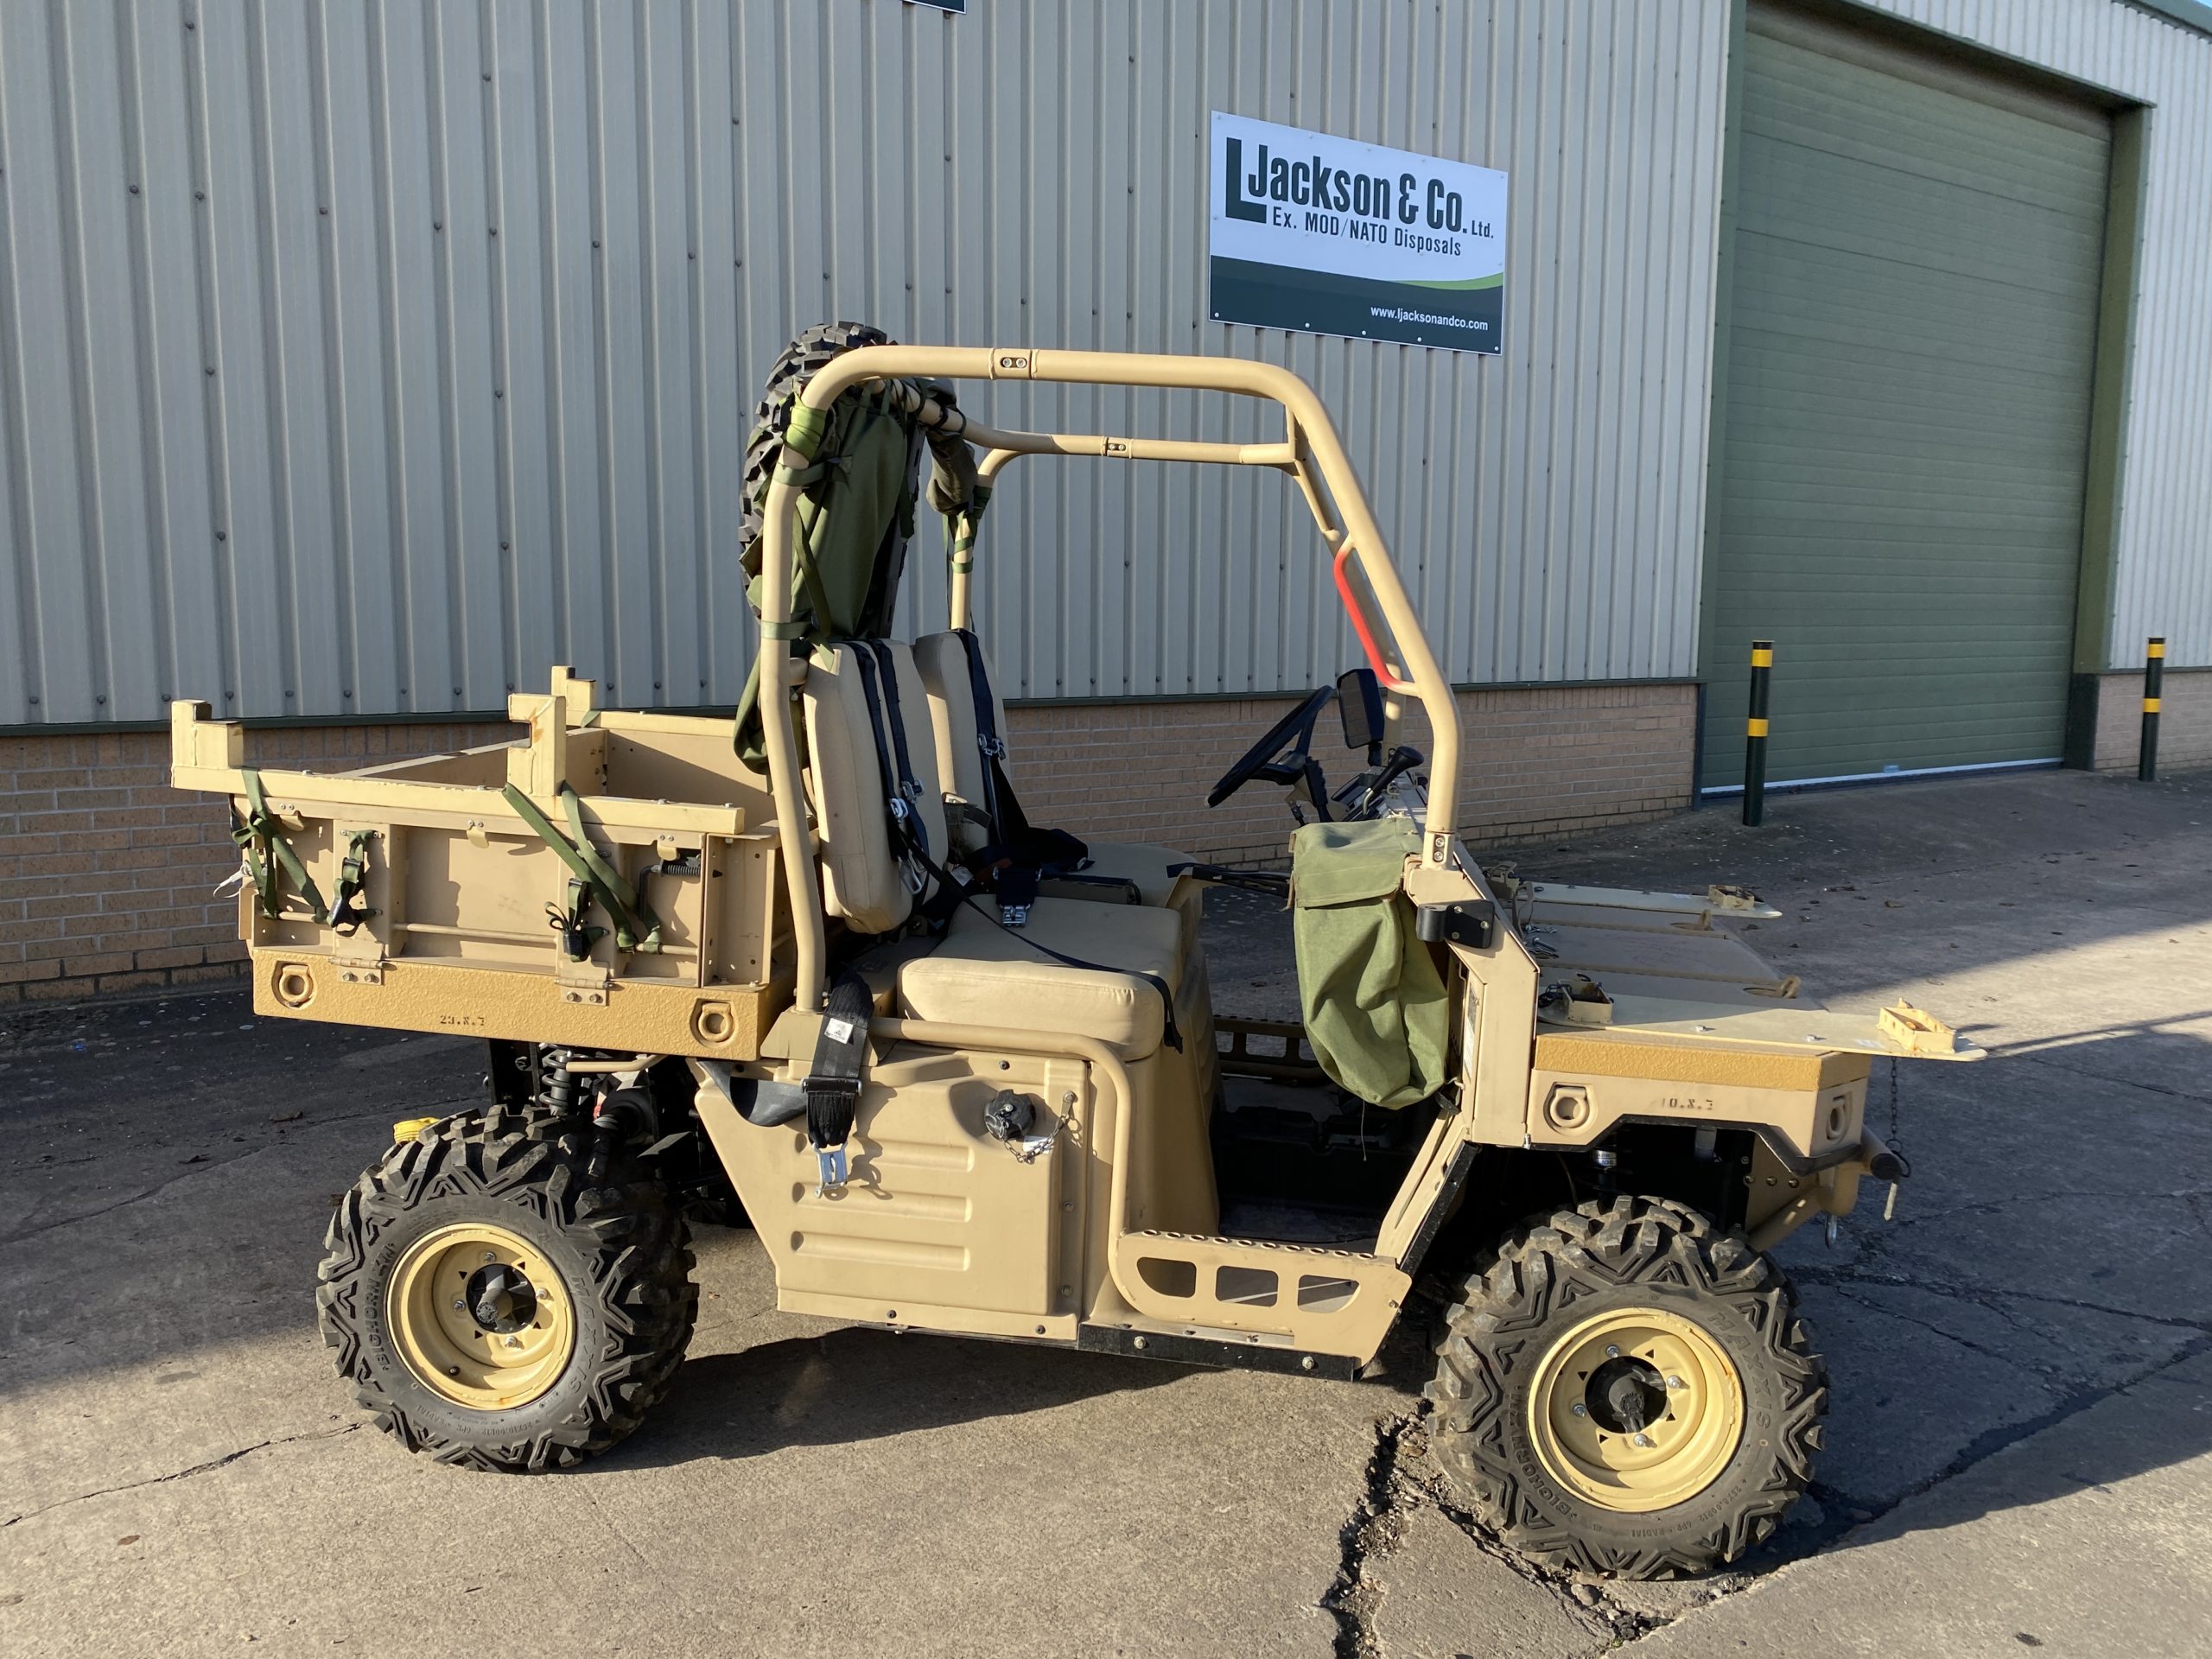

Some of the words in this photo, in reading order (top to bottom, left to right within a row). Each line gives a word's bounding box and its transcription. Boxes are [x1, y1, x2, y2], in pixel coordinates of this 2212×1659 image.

[1273, 207, 1297, 229] Ex.
[1305, 212, 1387, 244] MOD/NATO
[1395, 227, 1461, 256] Disposals
[1399, 173, 1419, 224] &
[1427, 178, 1467, 232] Co.
[1471, 219, 1494, 238] Ltd.
[1370, 307, 1488, 330] www.ljacksonandco.com
[364, 1278, 391, 1367] BIGHORN
[1707, 1312, 1772, 1430] MAXXIS
